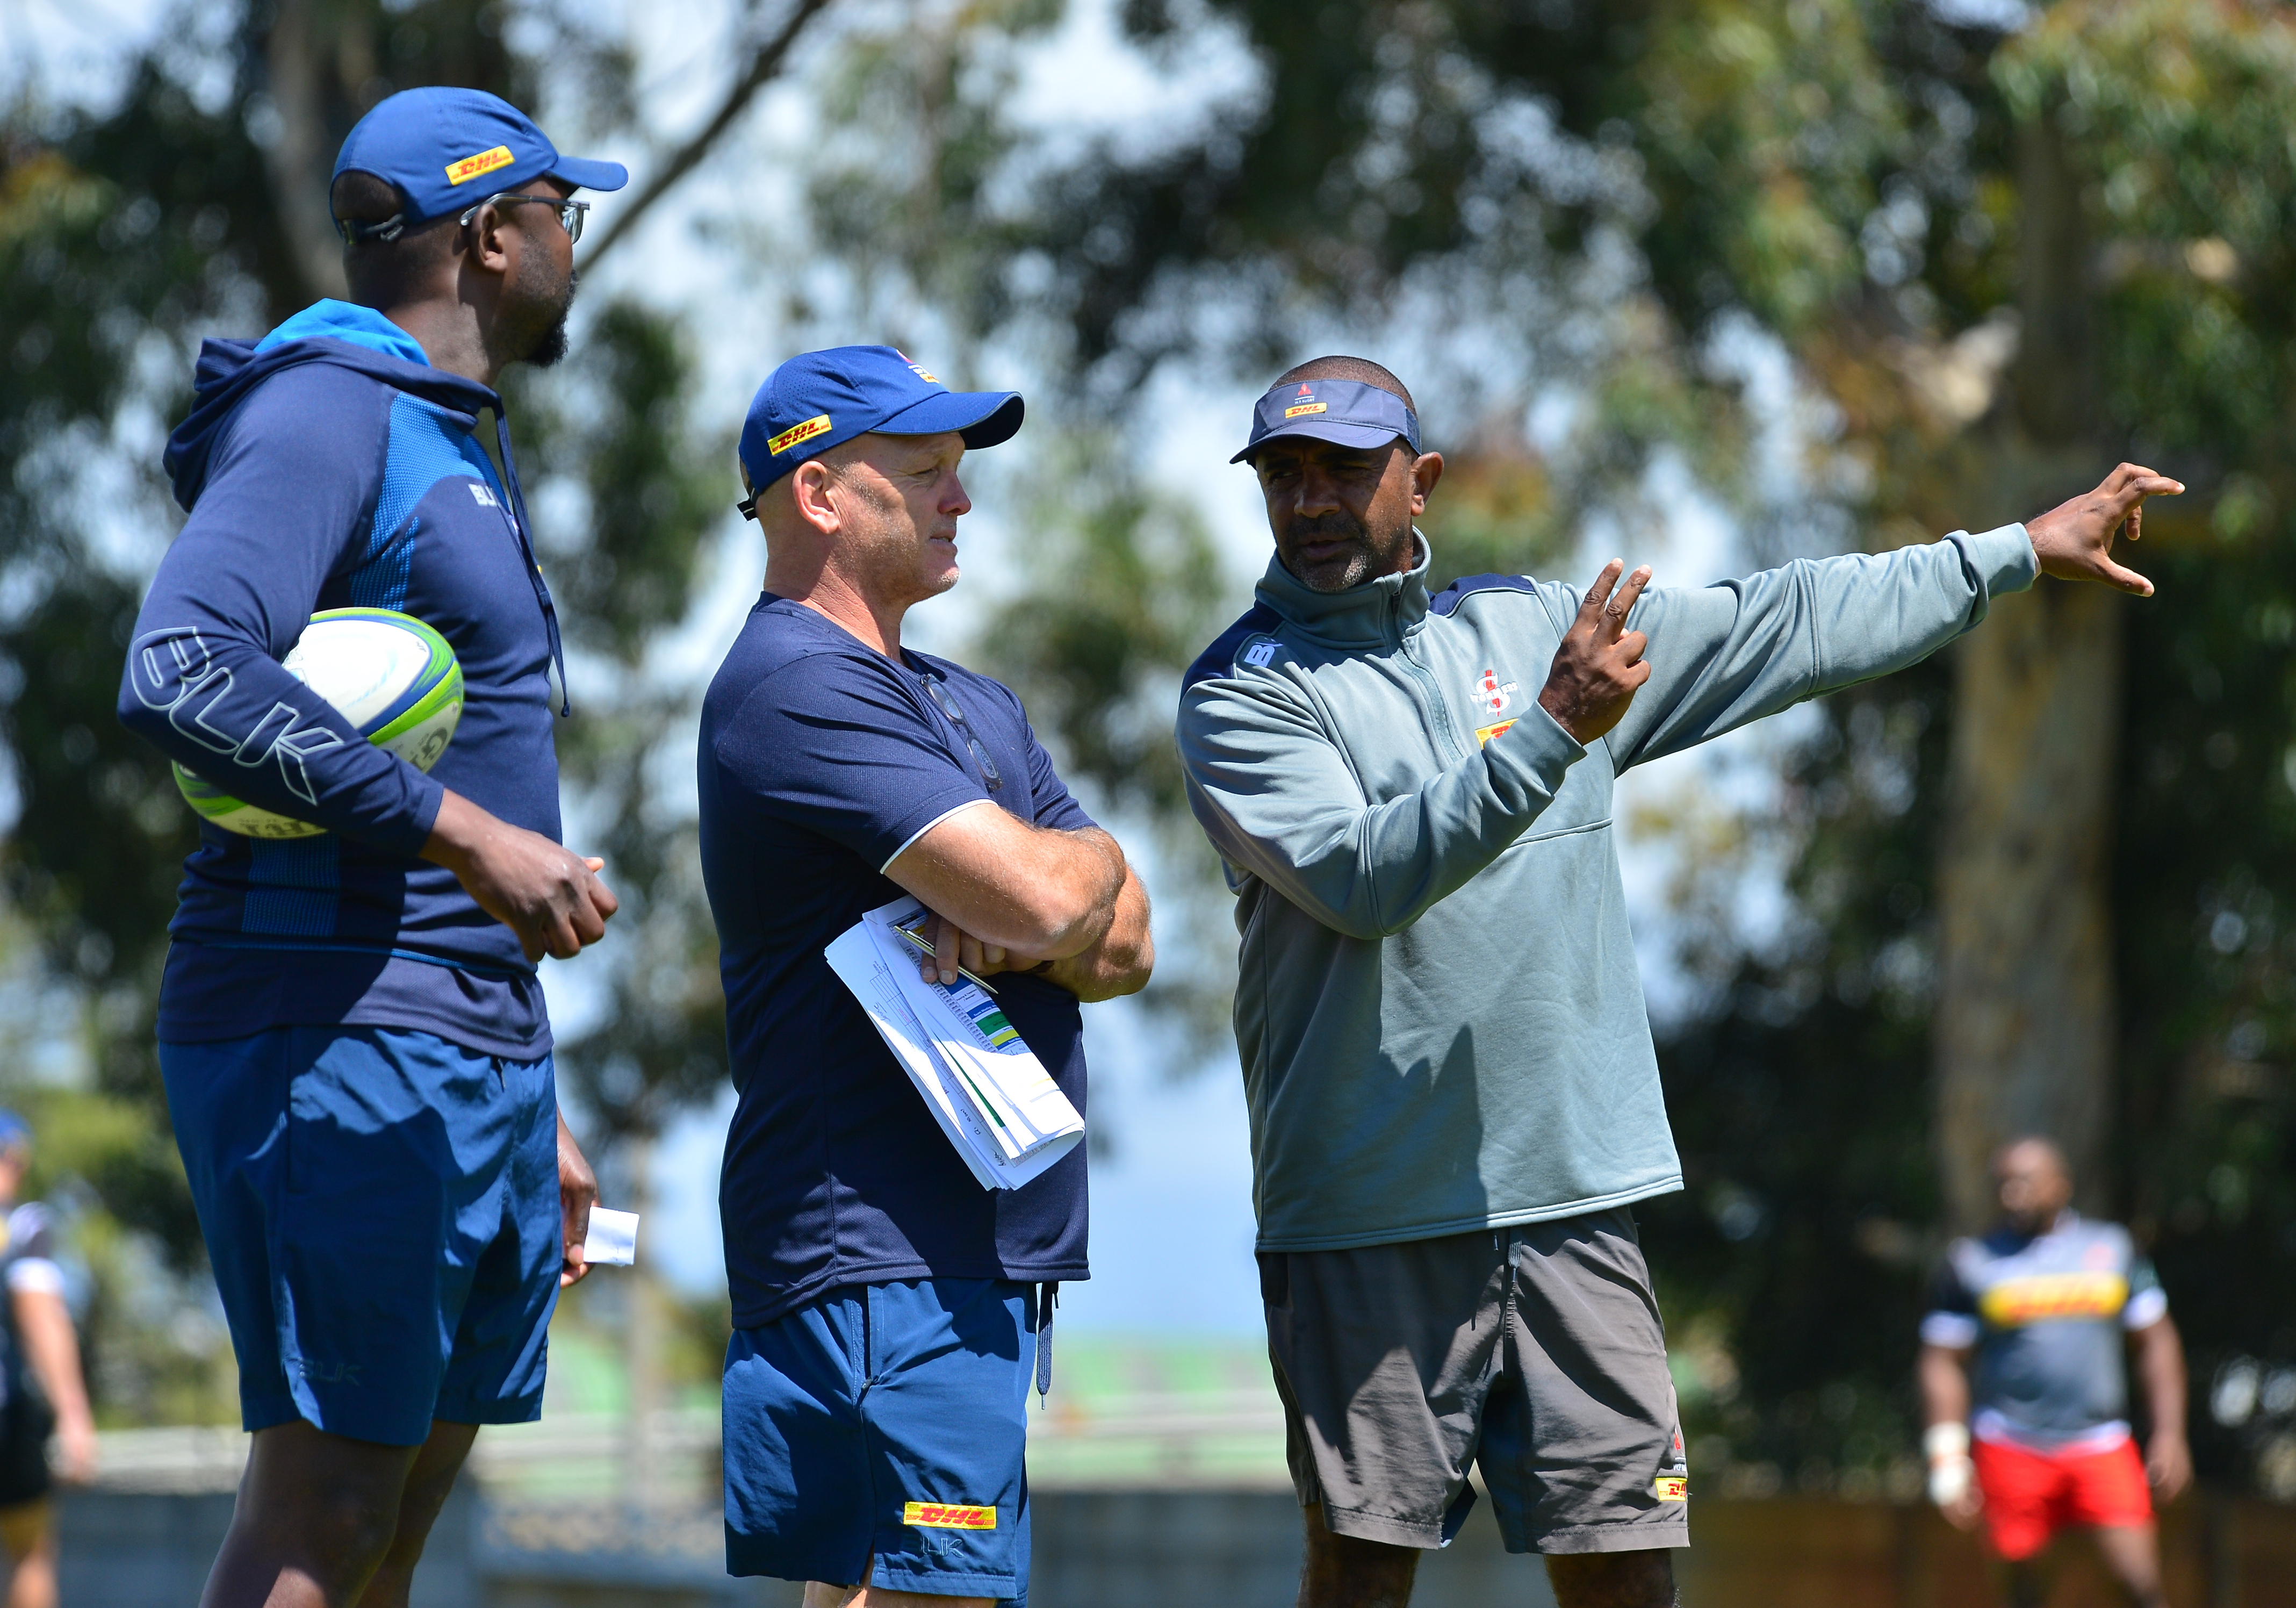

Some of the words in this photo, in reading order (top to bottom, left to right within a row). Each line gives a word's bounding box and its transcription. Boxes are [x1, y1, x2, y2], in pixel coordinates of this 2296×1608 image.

[458, 153, 503, 176] DHL
[1291, 405, 1320, 415] DHL
[778, 422, 819, 448] DHL
[468, 484, 498, 507] BL
[131, 626, 345, 806] BLK
[919, 1507, 985, 1526] DHL
